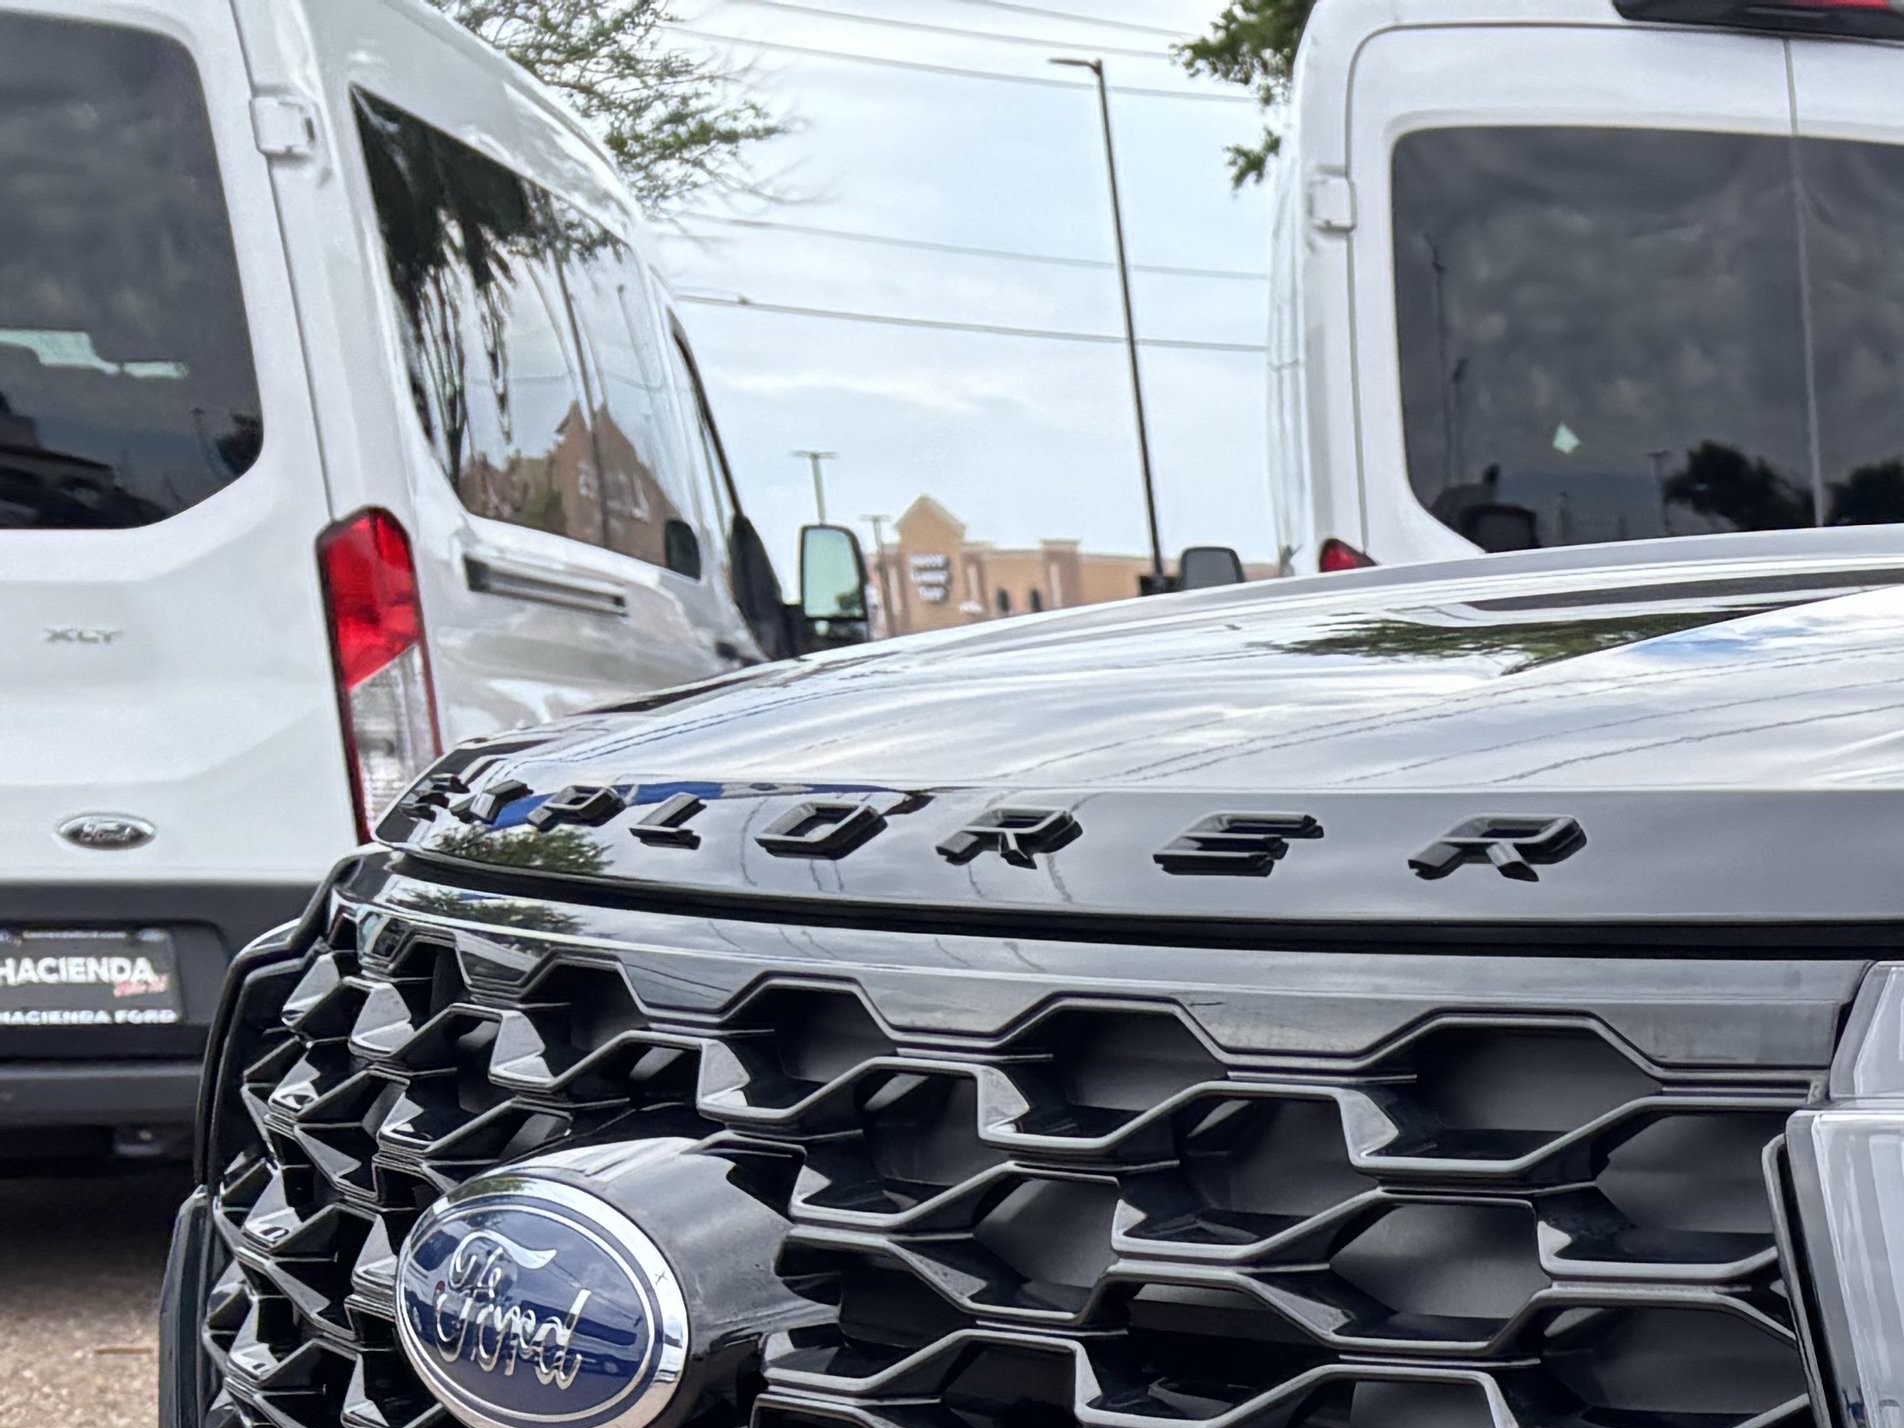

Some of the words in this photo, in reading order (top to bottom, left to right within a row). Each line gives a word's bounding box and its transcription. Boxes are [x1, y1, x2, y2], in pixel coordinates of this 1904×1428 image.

[43, 628, 123, 644] XLT
[0, 956, 158, 986] HACIENDA
[433, 1229, 592, 1391] Ford
